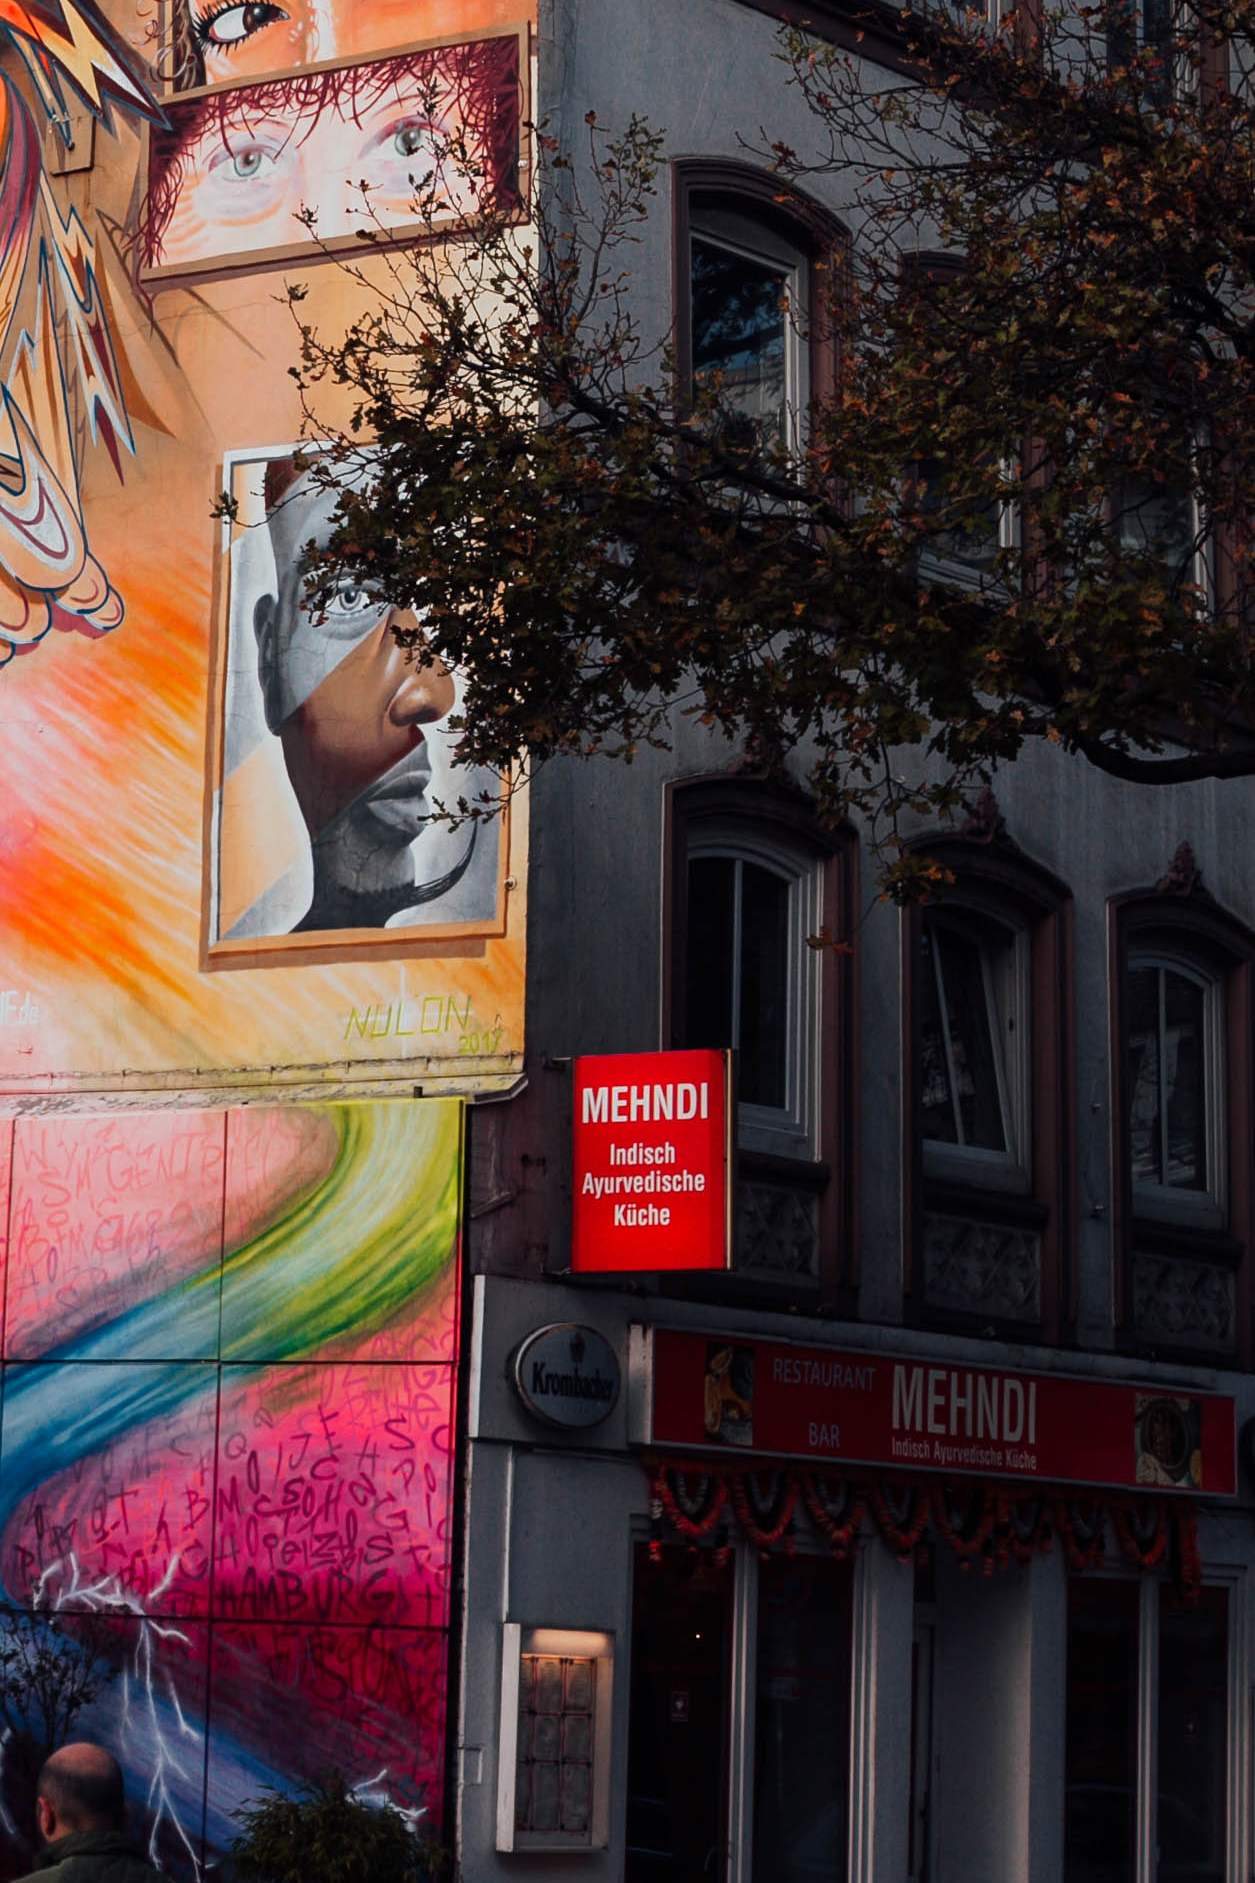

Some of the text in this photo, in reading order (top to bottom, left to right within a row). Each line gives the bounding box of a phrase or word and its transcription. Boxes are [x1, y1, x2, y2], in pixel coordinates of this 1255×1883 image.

[344, 995, 473, 1040] NULON
[458, 1029, 503, 1054] 2017
[582, 1082, 709, 1124] MEHNDI
[610, 1142, 676, 1166] Indisch
[582, 1170, 705, 1200] Ayurvedische
[614, 1203, 671, 1227] Küche
[772, 1357, 877, 1391] RESTAURANT
[891, 1363, 1037, 1446] MEHNDI
[808, 1421, 841, 1449] BAR
[891, 1435, 1038, 1470] Indisch Ayurvedische Küche
